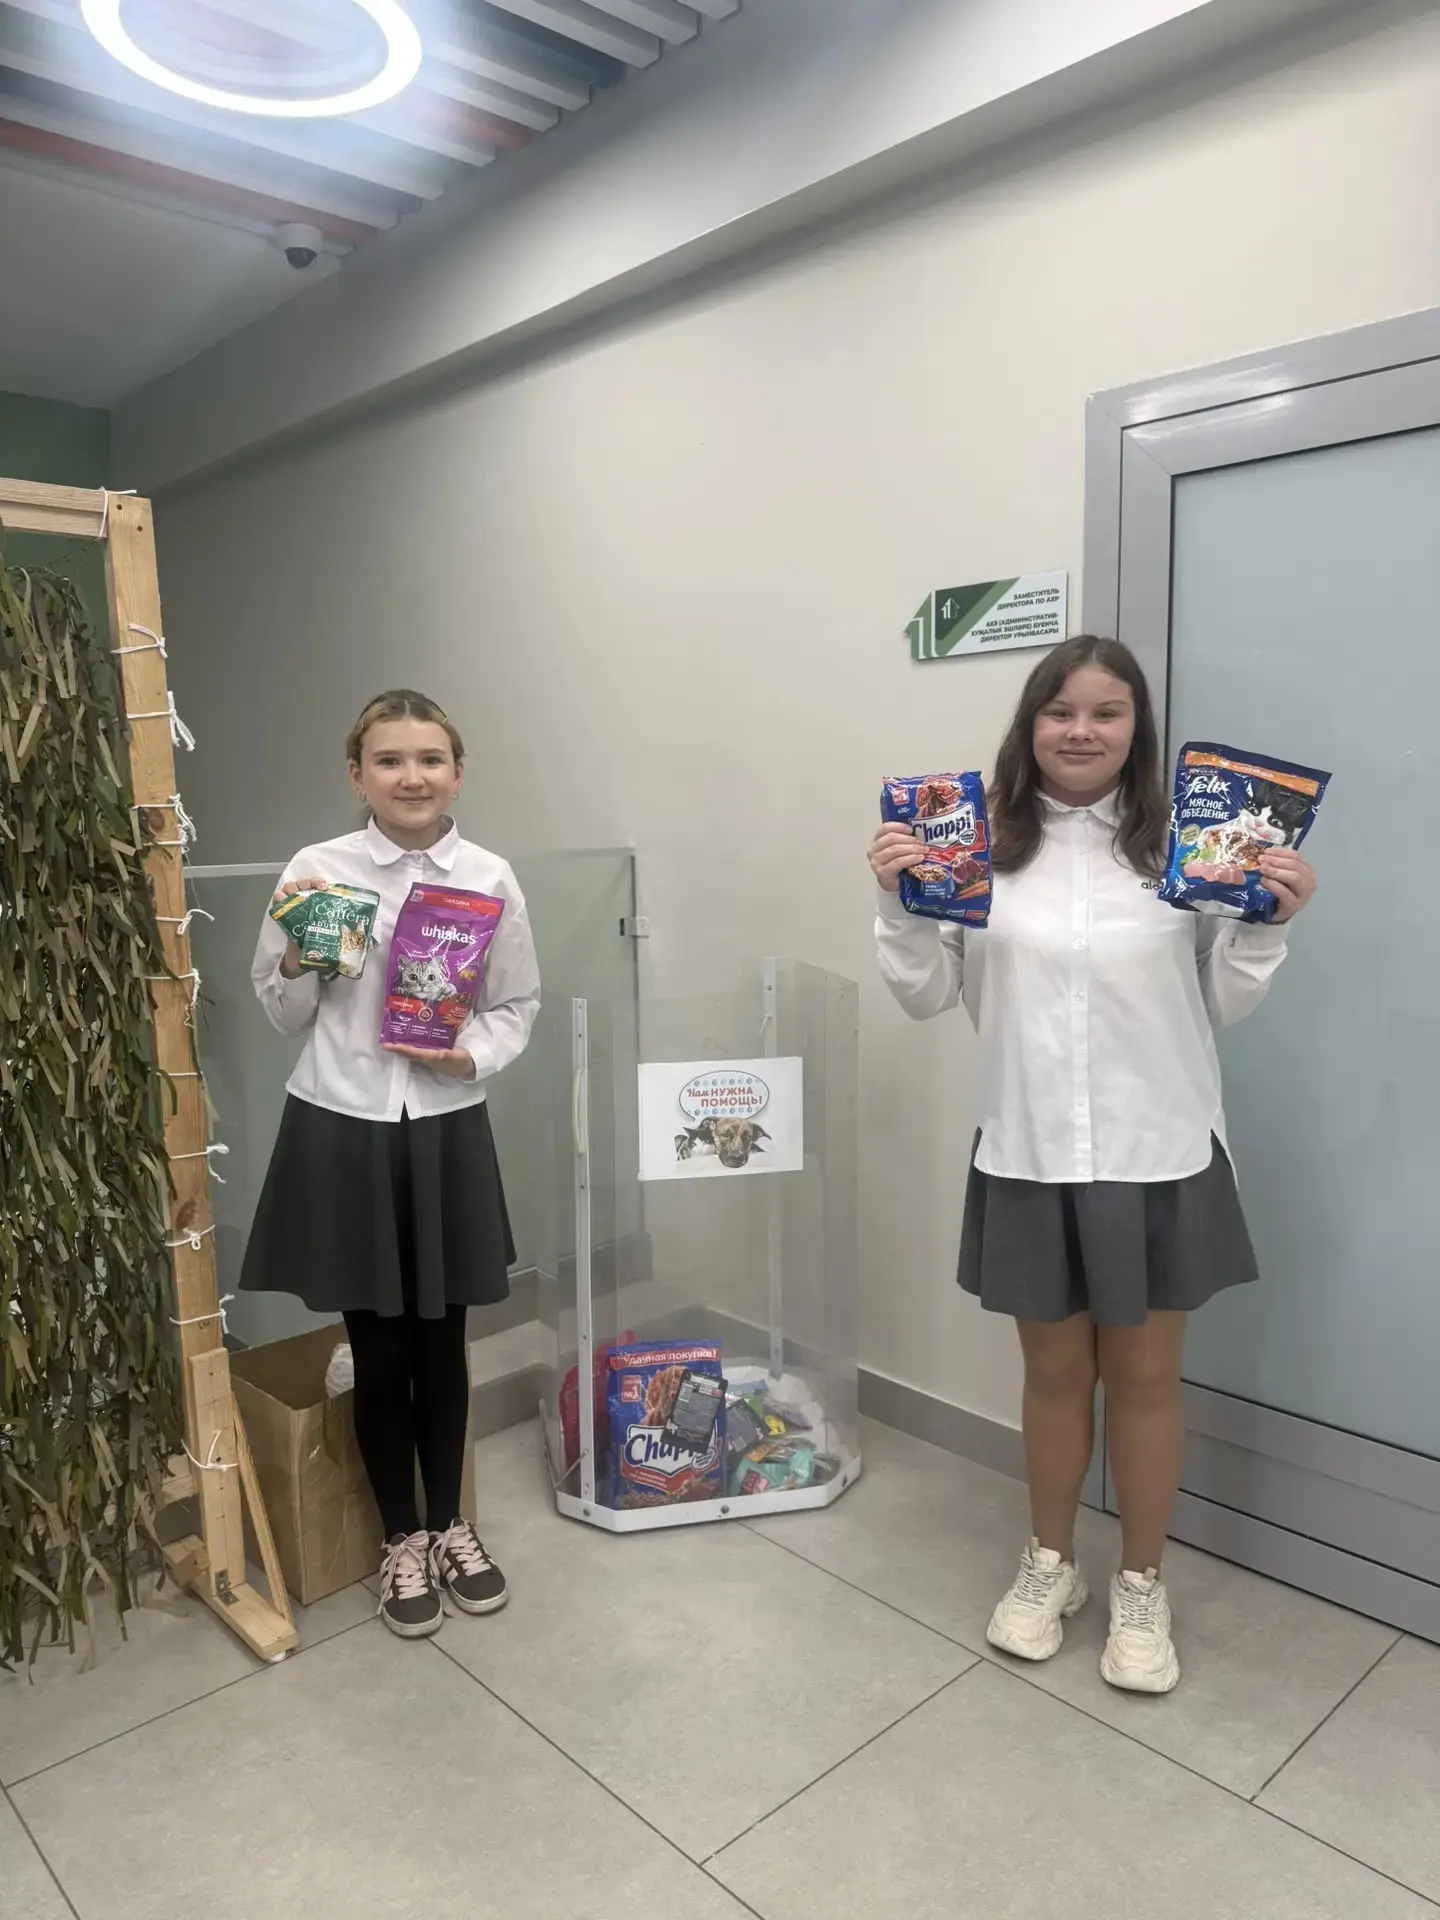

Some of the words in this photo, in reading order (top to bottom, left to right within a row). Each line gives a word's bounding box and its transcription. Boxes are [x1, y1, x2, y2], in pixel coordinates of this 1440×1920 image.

[1013, 588, 1060, 600] ЗАМЕСТИТЕЛЬ
[997, 599, 1034, 611] ДИРЕКТОРА
[1046, 595, 1060, 603] АХР
[998, 612, 1059, 626] (АДМИНИСТРАТИВ-
[1033, 620, 1058, 629] БУЕНЧА
[980, 633, 1012, 643] ДИРЕКТОР
[1013, 628, 1059, 639] УРЫНБАСАРЫ
[1184, 775, 1231, 800] felix
[1189, 798, 1224, 811] МЯСНОЕ
[1181, 808, 1230, 821] ОБЪЕДЕНИЕ
[421, 924, 477, 945] whiskas
[686, 1087, 710, 1097] Нам
[711, 1086, 754, 1097] НУЖНА
[701, 1095, 763, 1108] ПОМОЩЬ!
[668, 1348, 717, 1361] покупка!
